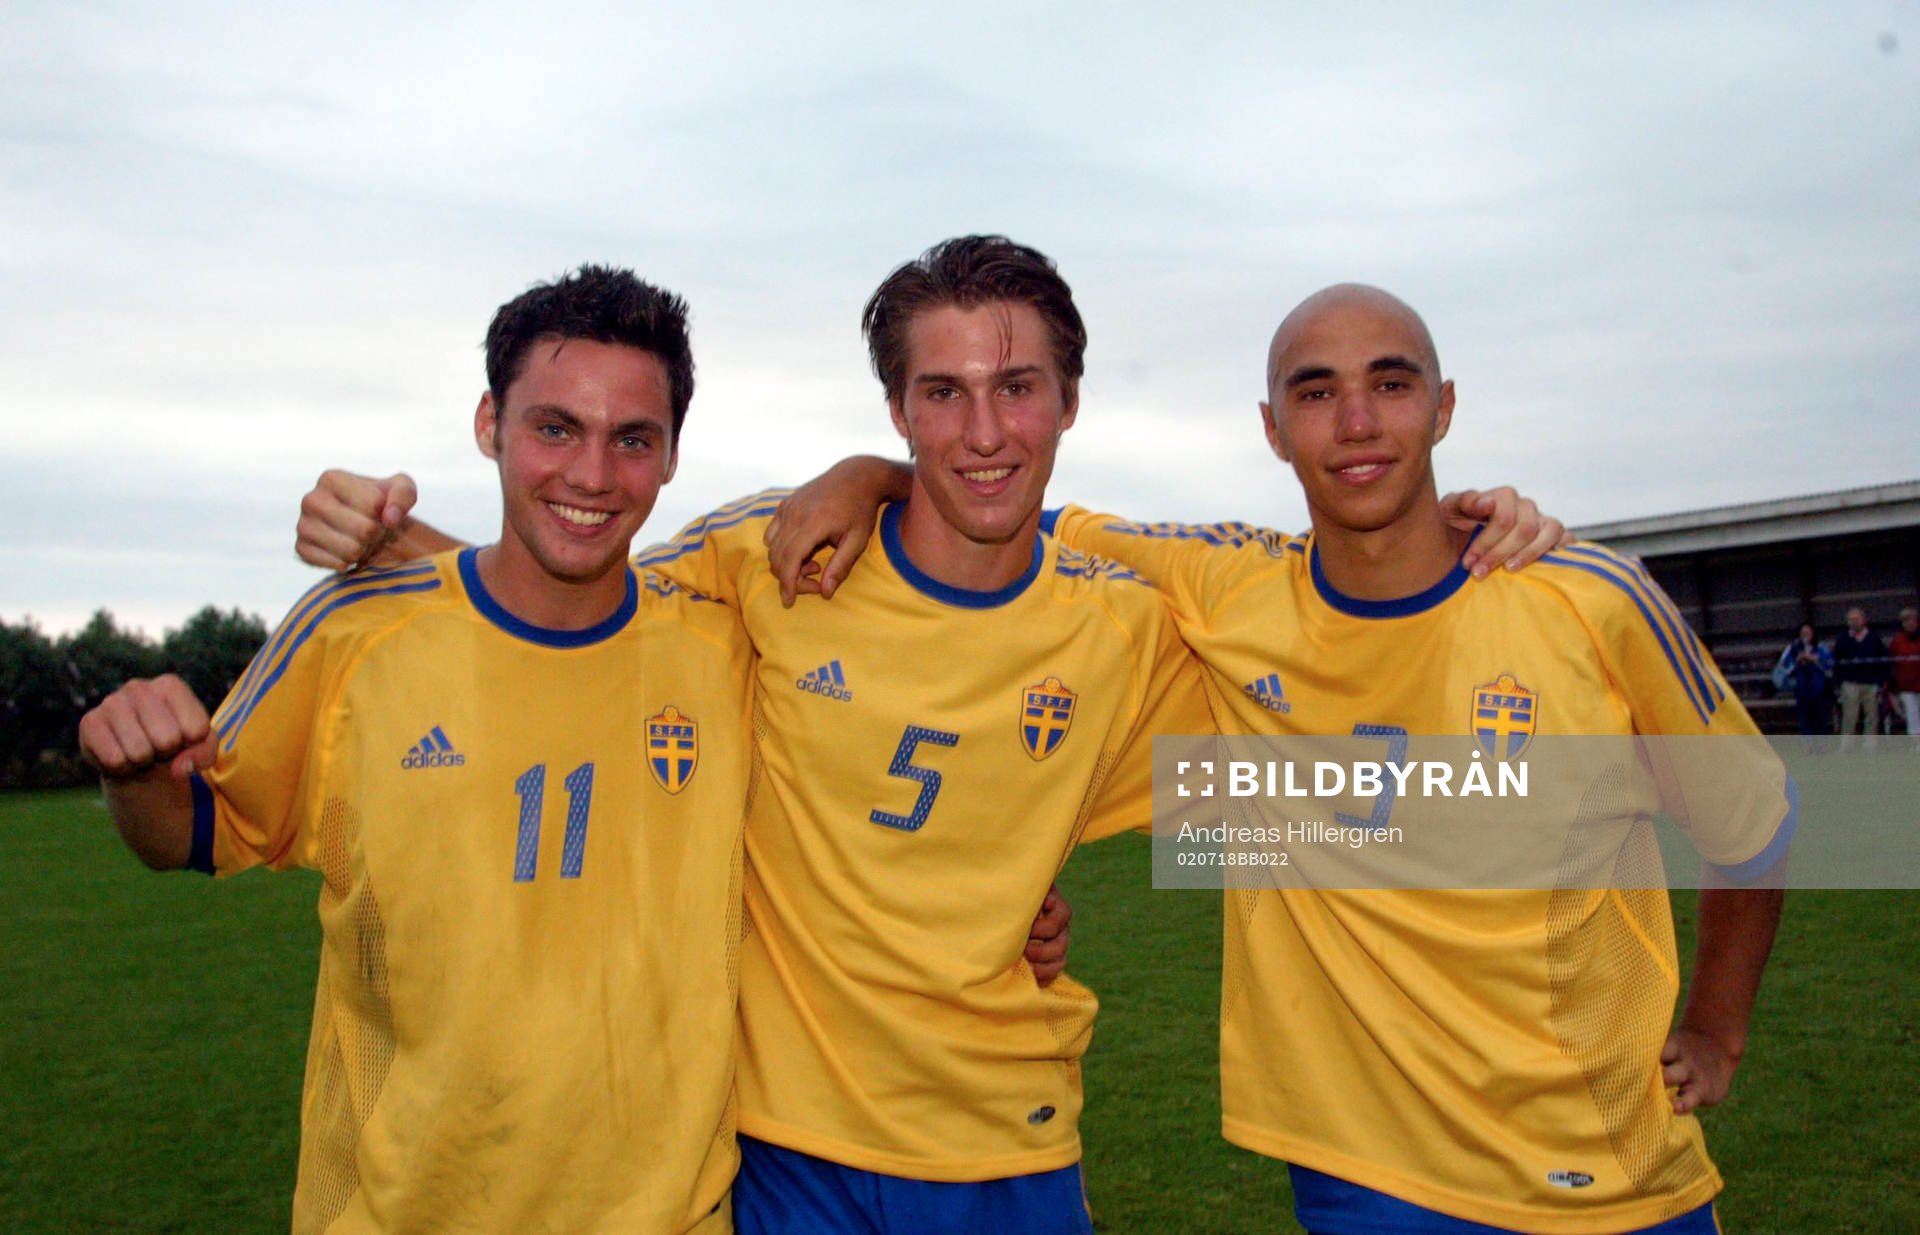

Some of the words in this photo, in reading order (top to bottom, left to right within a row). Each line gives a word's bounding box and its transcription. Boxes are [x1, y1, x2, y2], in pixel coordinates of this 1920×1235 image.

[796, 677, 853, 702] adidas
[401, 751, 465, 770] adidas
[869, 724, 960, 833] 5
[513, 762, 594, 883] 11
